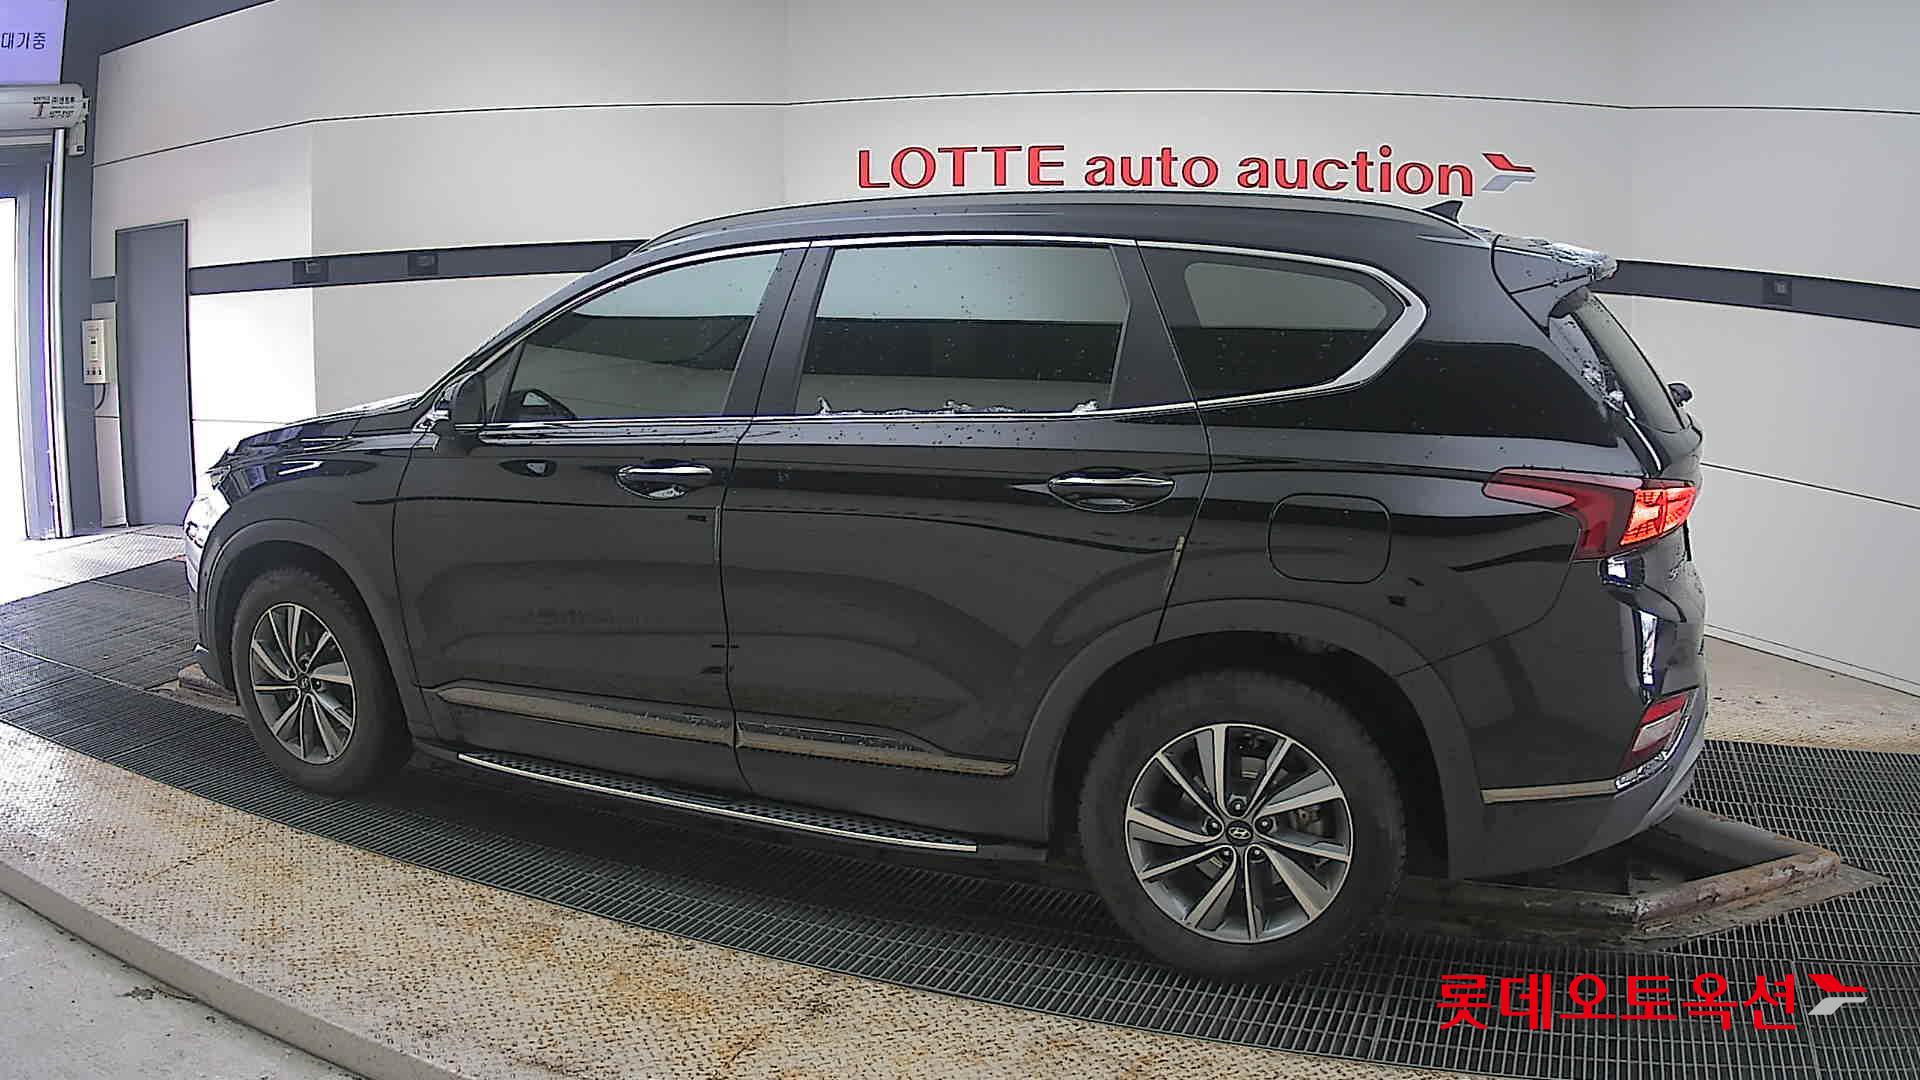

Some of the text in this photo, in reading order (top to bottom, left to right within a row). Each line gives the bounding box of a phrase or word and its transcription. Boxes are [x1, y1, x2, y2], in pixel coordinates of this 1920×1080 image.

[1, 32, 46, 50] 대기중
[858, 144, 1474, 197] LOTTE auto auction
